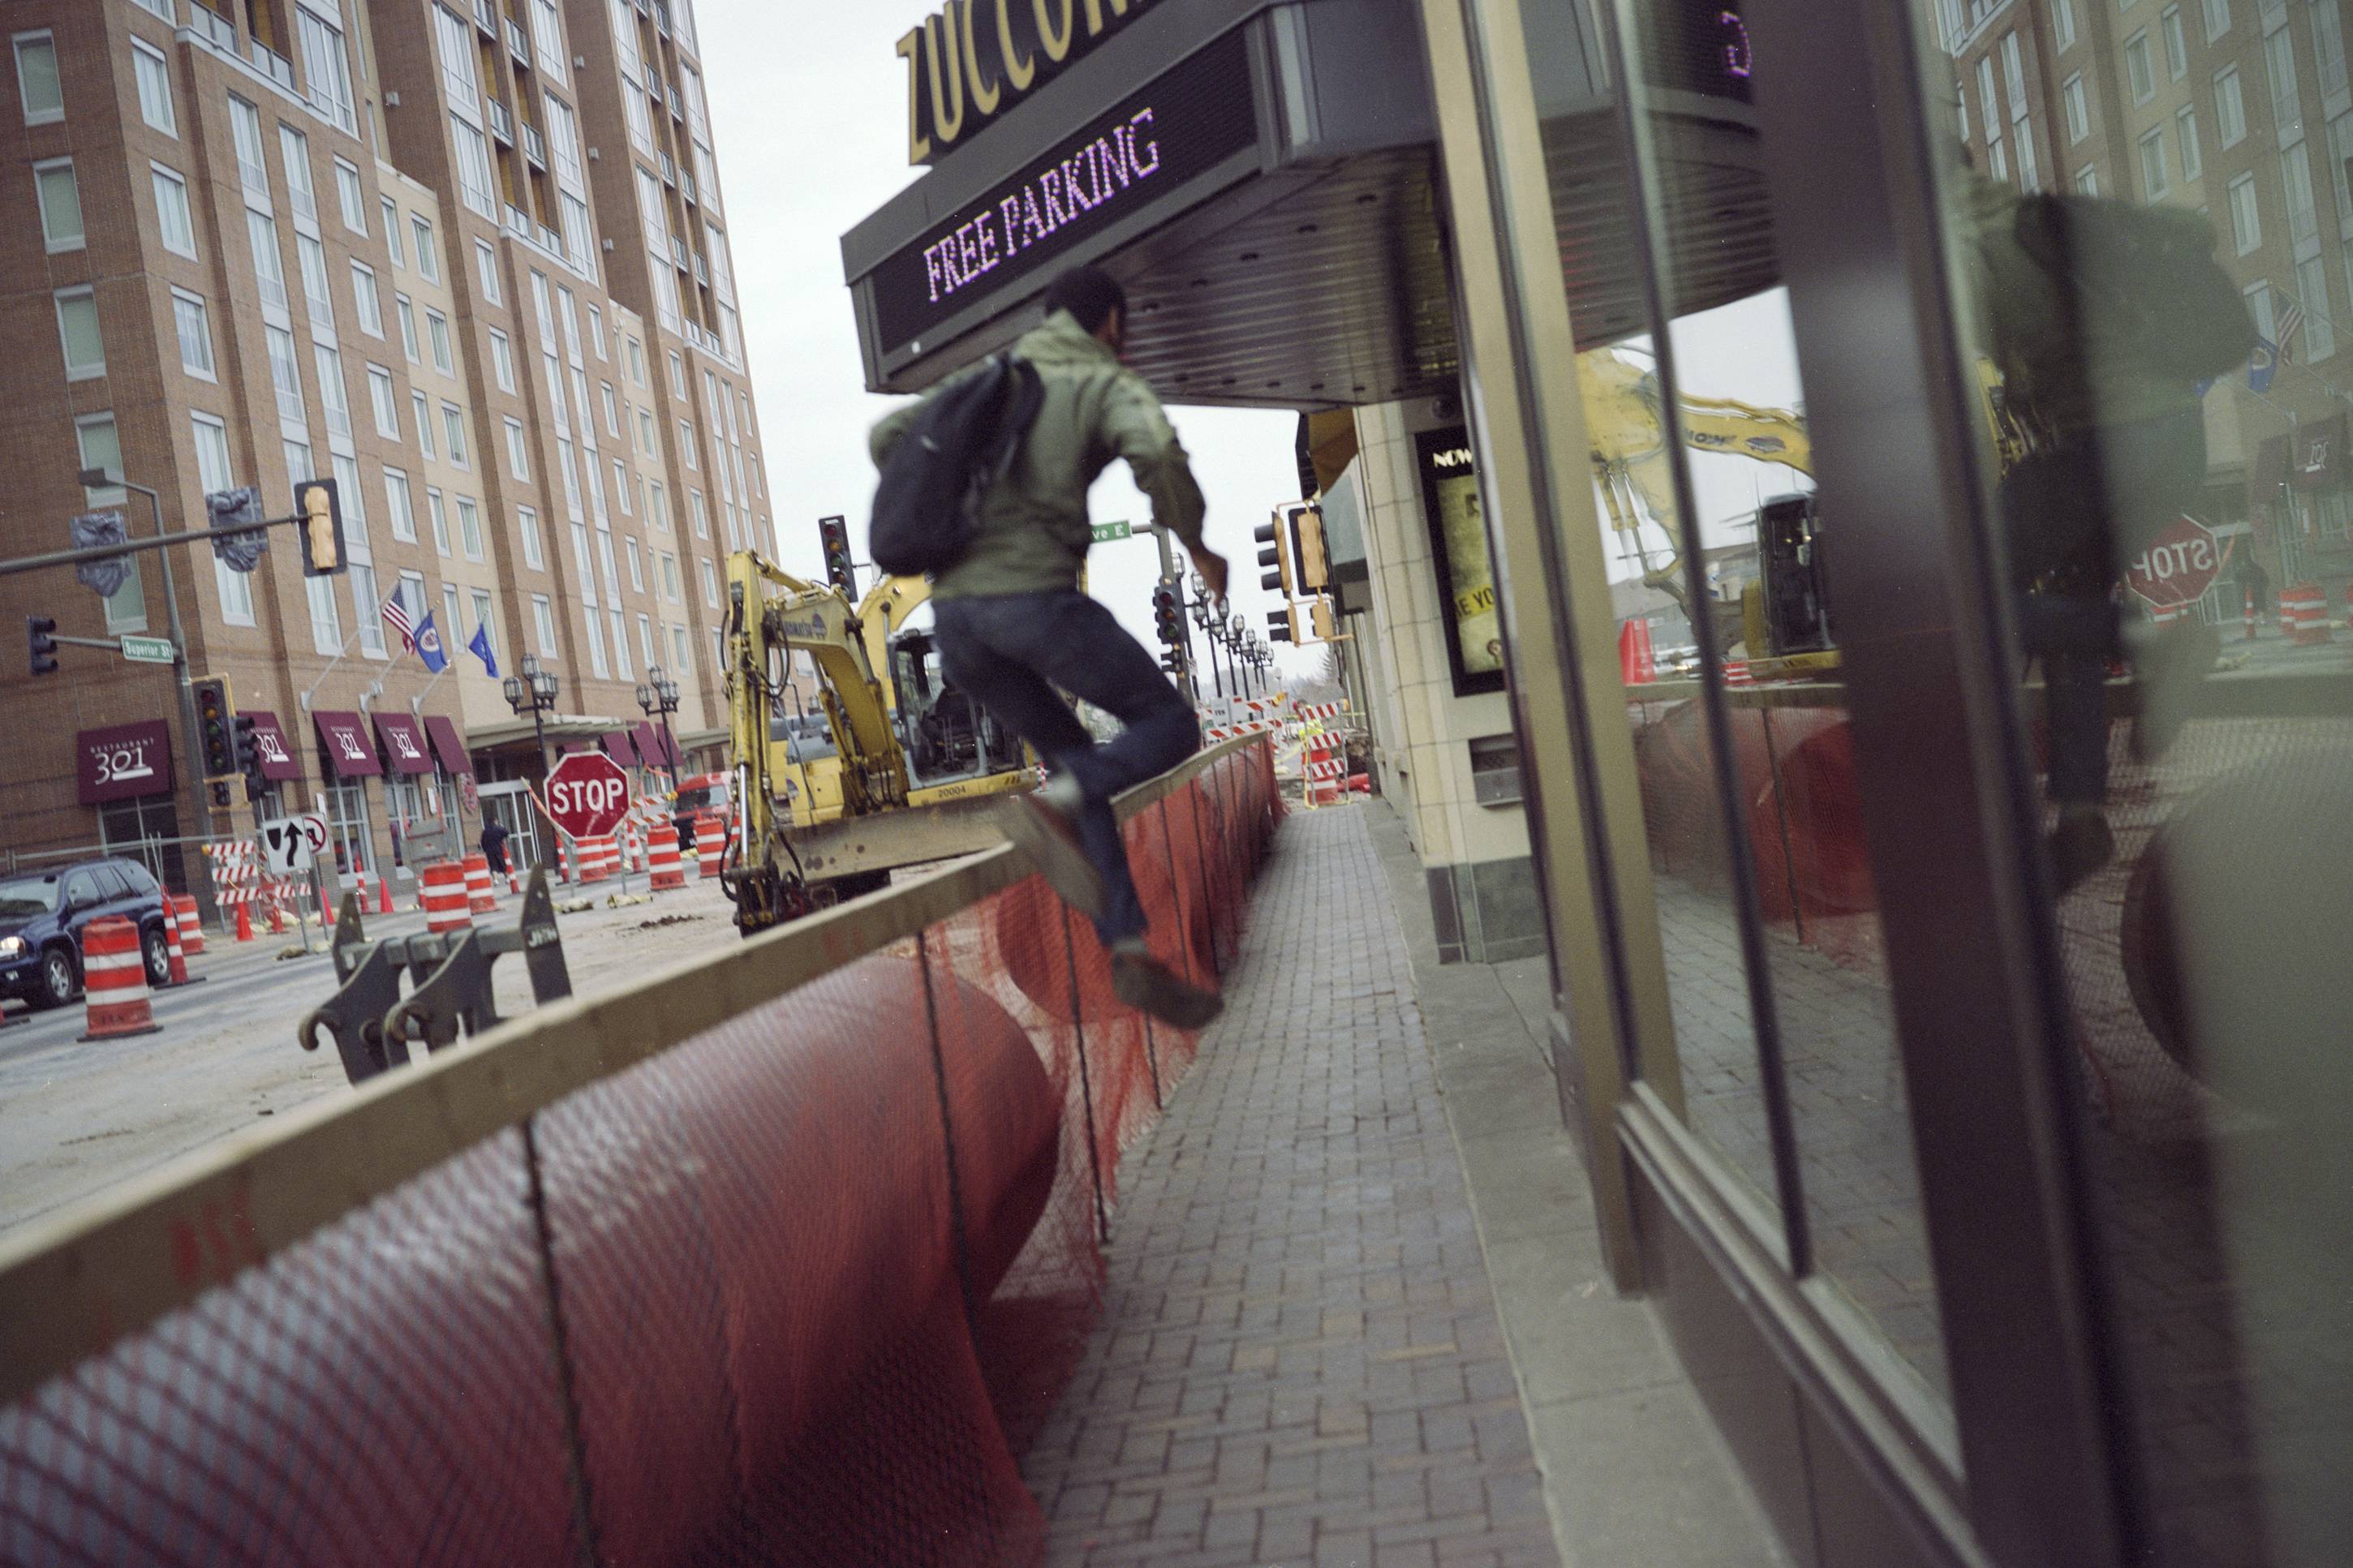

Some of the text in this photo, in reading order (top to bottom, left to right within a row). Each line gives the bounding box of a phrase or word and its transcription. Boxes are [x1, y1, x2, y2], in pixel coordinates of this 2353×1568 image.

[923, 106, 1160, 302] FREE PARKING
[1090, 523, 1125, 542] ve E
[124, 640, 171, 659] Superior St
[255, 732, 285, 763] 301
[334, 732, 361, 760] 301
[392, 732, 416, 759] 301
[94, 746, 149, 785] 301
[553, 778, 624, 814] STOP
